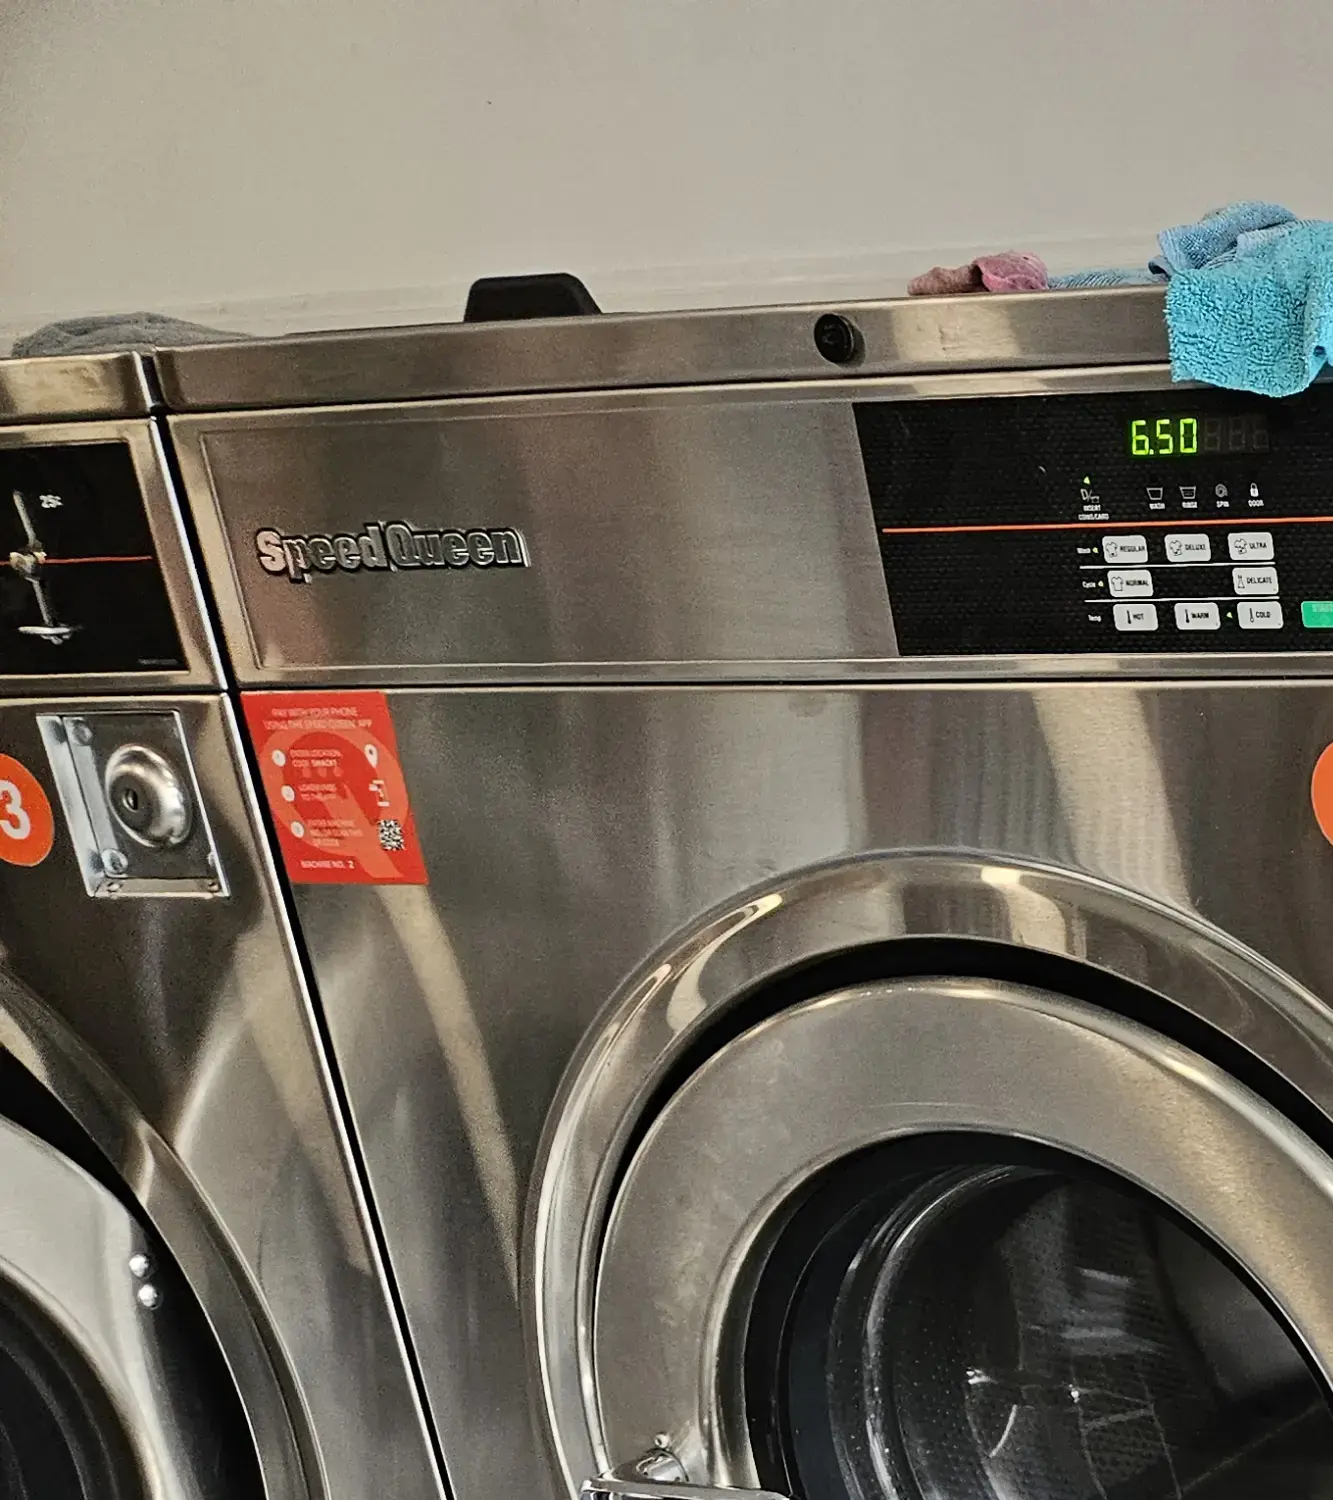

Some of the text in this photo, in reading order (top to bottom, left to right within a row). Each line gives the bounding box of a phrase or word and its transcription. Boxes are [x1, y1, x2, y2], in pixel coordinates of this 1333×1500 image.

[1132, 418, 1197, 455] 6.50
[256, 520, 532, 584] Speed Queen
[1119, 545, 1145, 553] REGULAR
[0, 779, 31, 840] 3
[348, 860, 354, 869] 2
